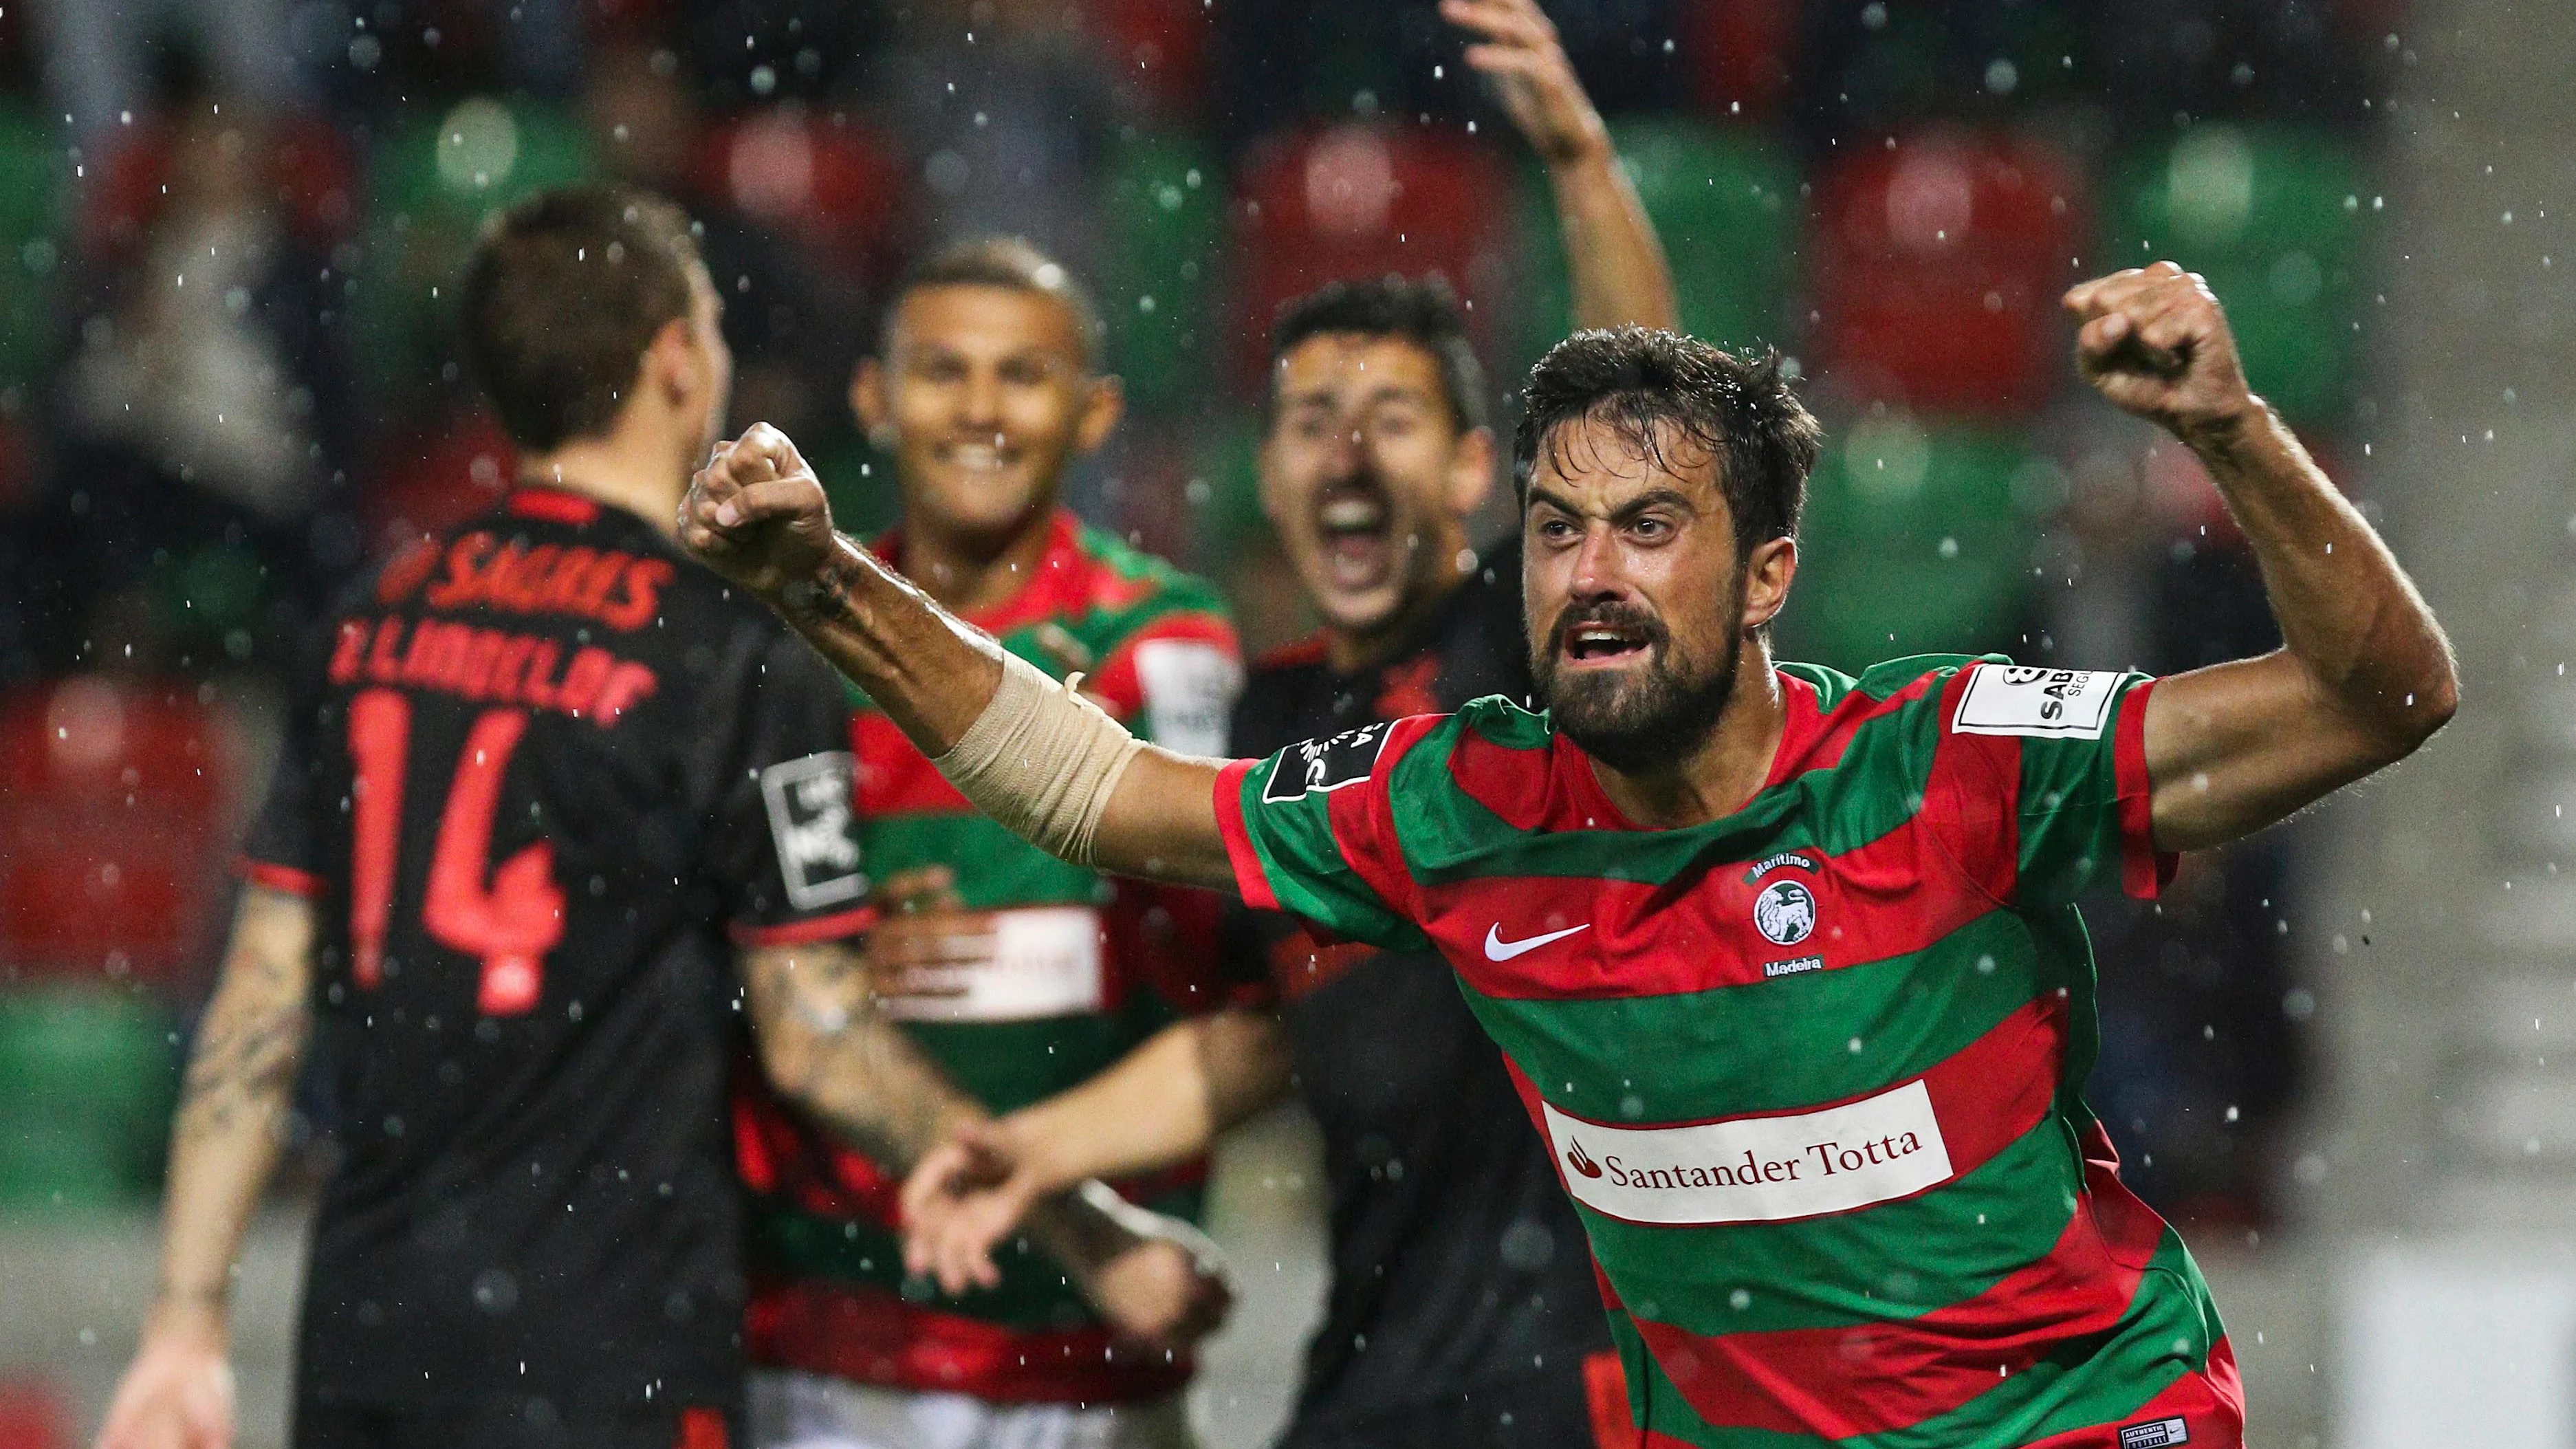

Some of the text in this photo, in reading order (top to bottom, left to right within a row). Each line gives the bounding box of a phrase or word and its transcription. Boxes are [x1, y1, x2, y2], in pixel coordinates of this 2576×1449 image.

[2040, 672, 2073, 720] SAB
[347, 689, 567, 1016] 14
[1765, 957, 1822, 977] Madeira
[1606, 1131, 1922, 1189] Santander Totta
[2125, 1425, 2164, 1438] AUTHENTIC
